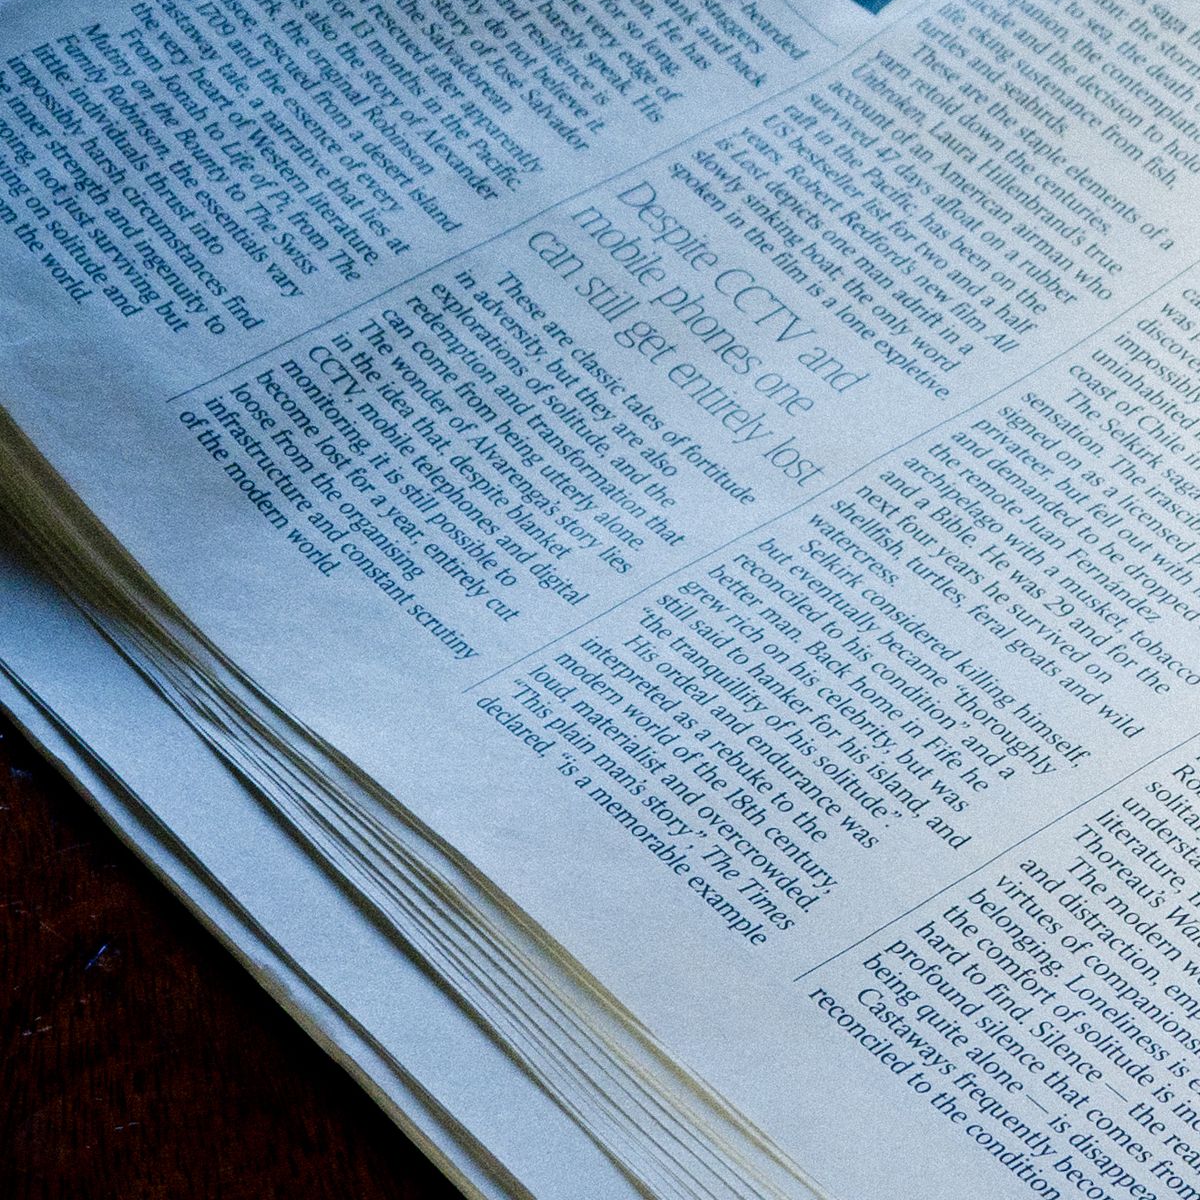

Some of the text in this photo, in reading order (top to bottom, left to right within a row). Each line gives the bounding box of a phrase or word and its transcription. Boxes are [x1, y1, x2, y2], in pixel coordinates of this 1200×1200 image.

[226, 38, 266, 69] and
[256, 68, 286, 94] the
[282, 97, 342, 153] essence
[338, 155, 367, 171] of
[356, 172, 403, 211] every
[496, 270, 755, 504] These are classic tales of fortitude
[527, 230, 824, 487] can still get entirely lost
[570, 205, 814, 417] mobile phones one
[617, 177, 870, 393] Despite CCTV and
[1019, 859, 1066, 893] and
[1058, 893, 1160, 986] distraction,
[1067, 855, 1107, 894] The
[1104, 895, 1182, 962] modern
